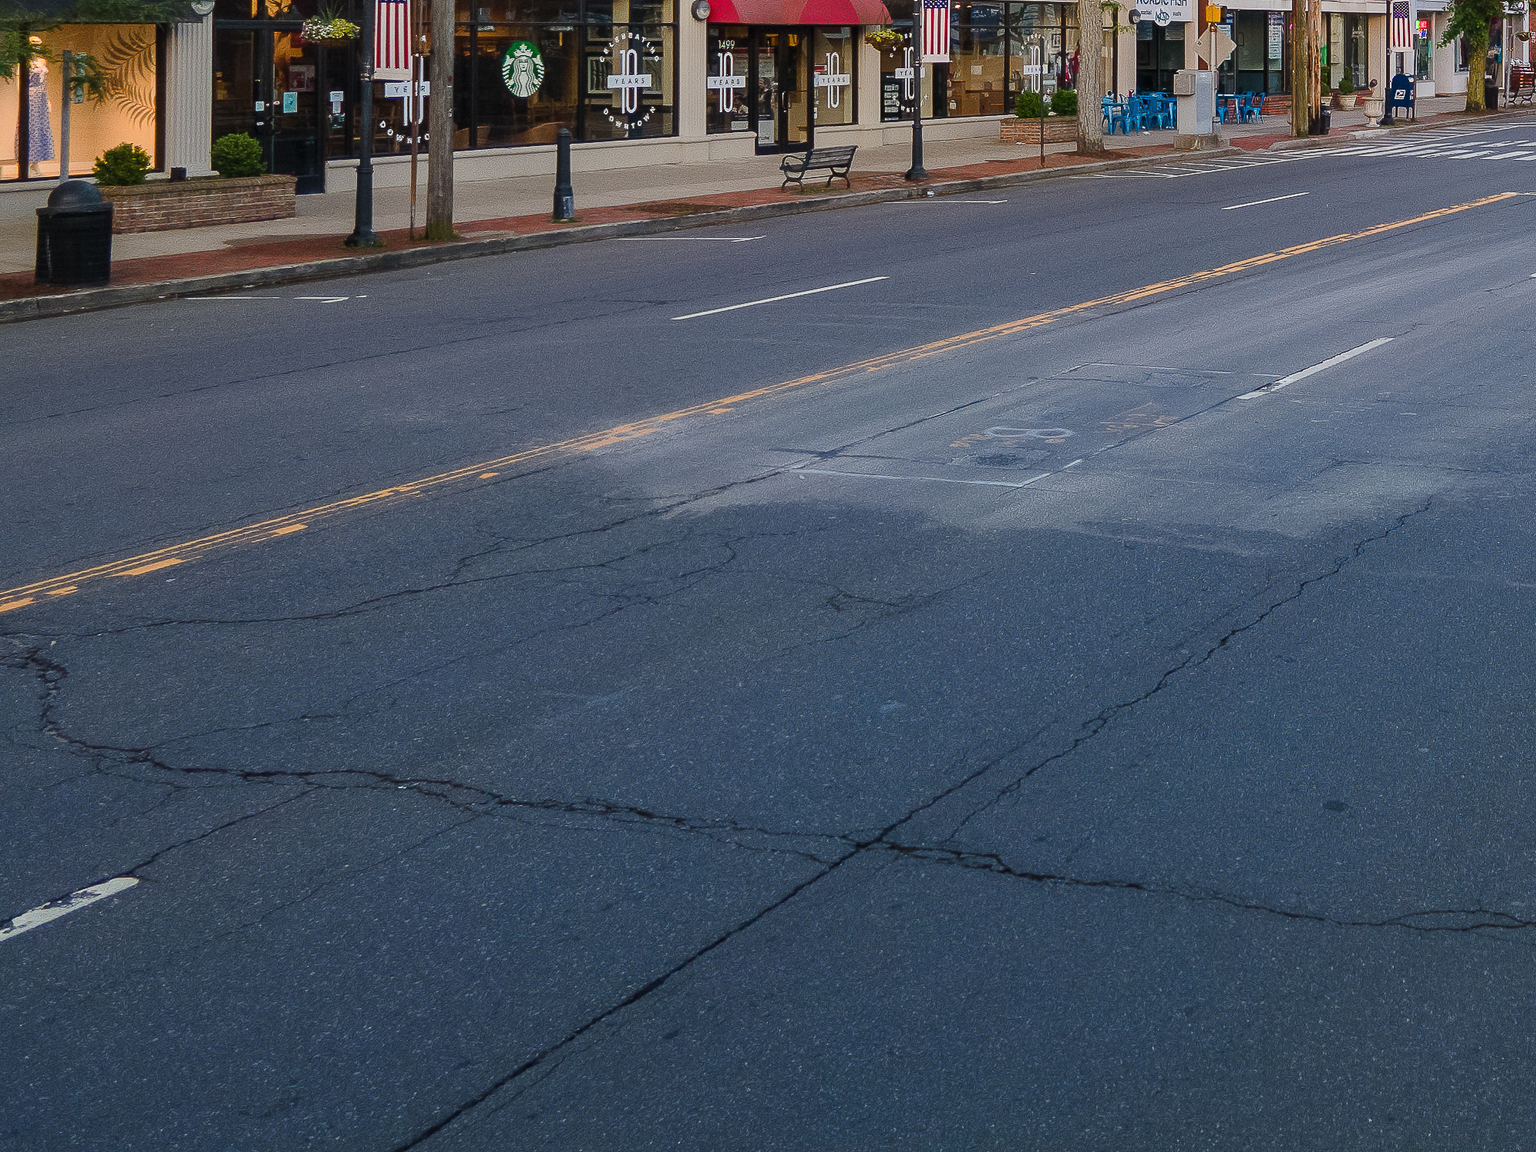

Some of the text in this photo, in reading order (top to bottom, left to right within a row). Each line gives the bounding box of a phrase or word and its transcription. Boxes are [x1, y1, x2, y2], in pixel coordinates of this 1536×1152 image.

[717, 39, 736, 50] 1499
[614, 77, 645, 85] YEARS
[620, 48, 638, 114] 10
[821, 76, 847, 84] YEARS
[826, 52, 840, 109] 10
[1030, 45, 1041, 94] 10
[713, 78, 741, 86] YEARS
[717, 51, 734, 113] 10
[603, 106, 656, 130] DOWNTOWN
